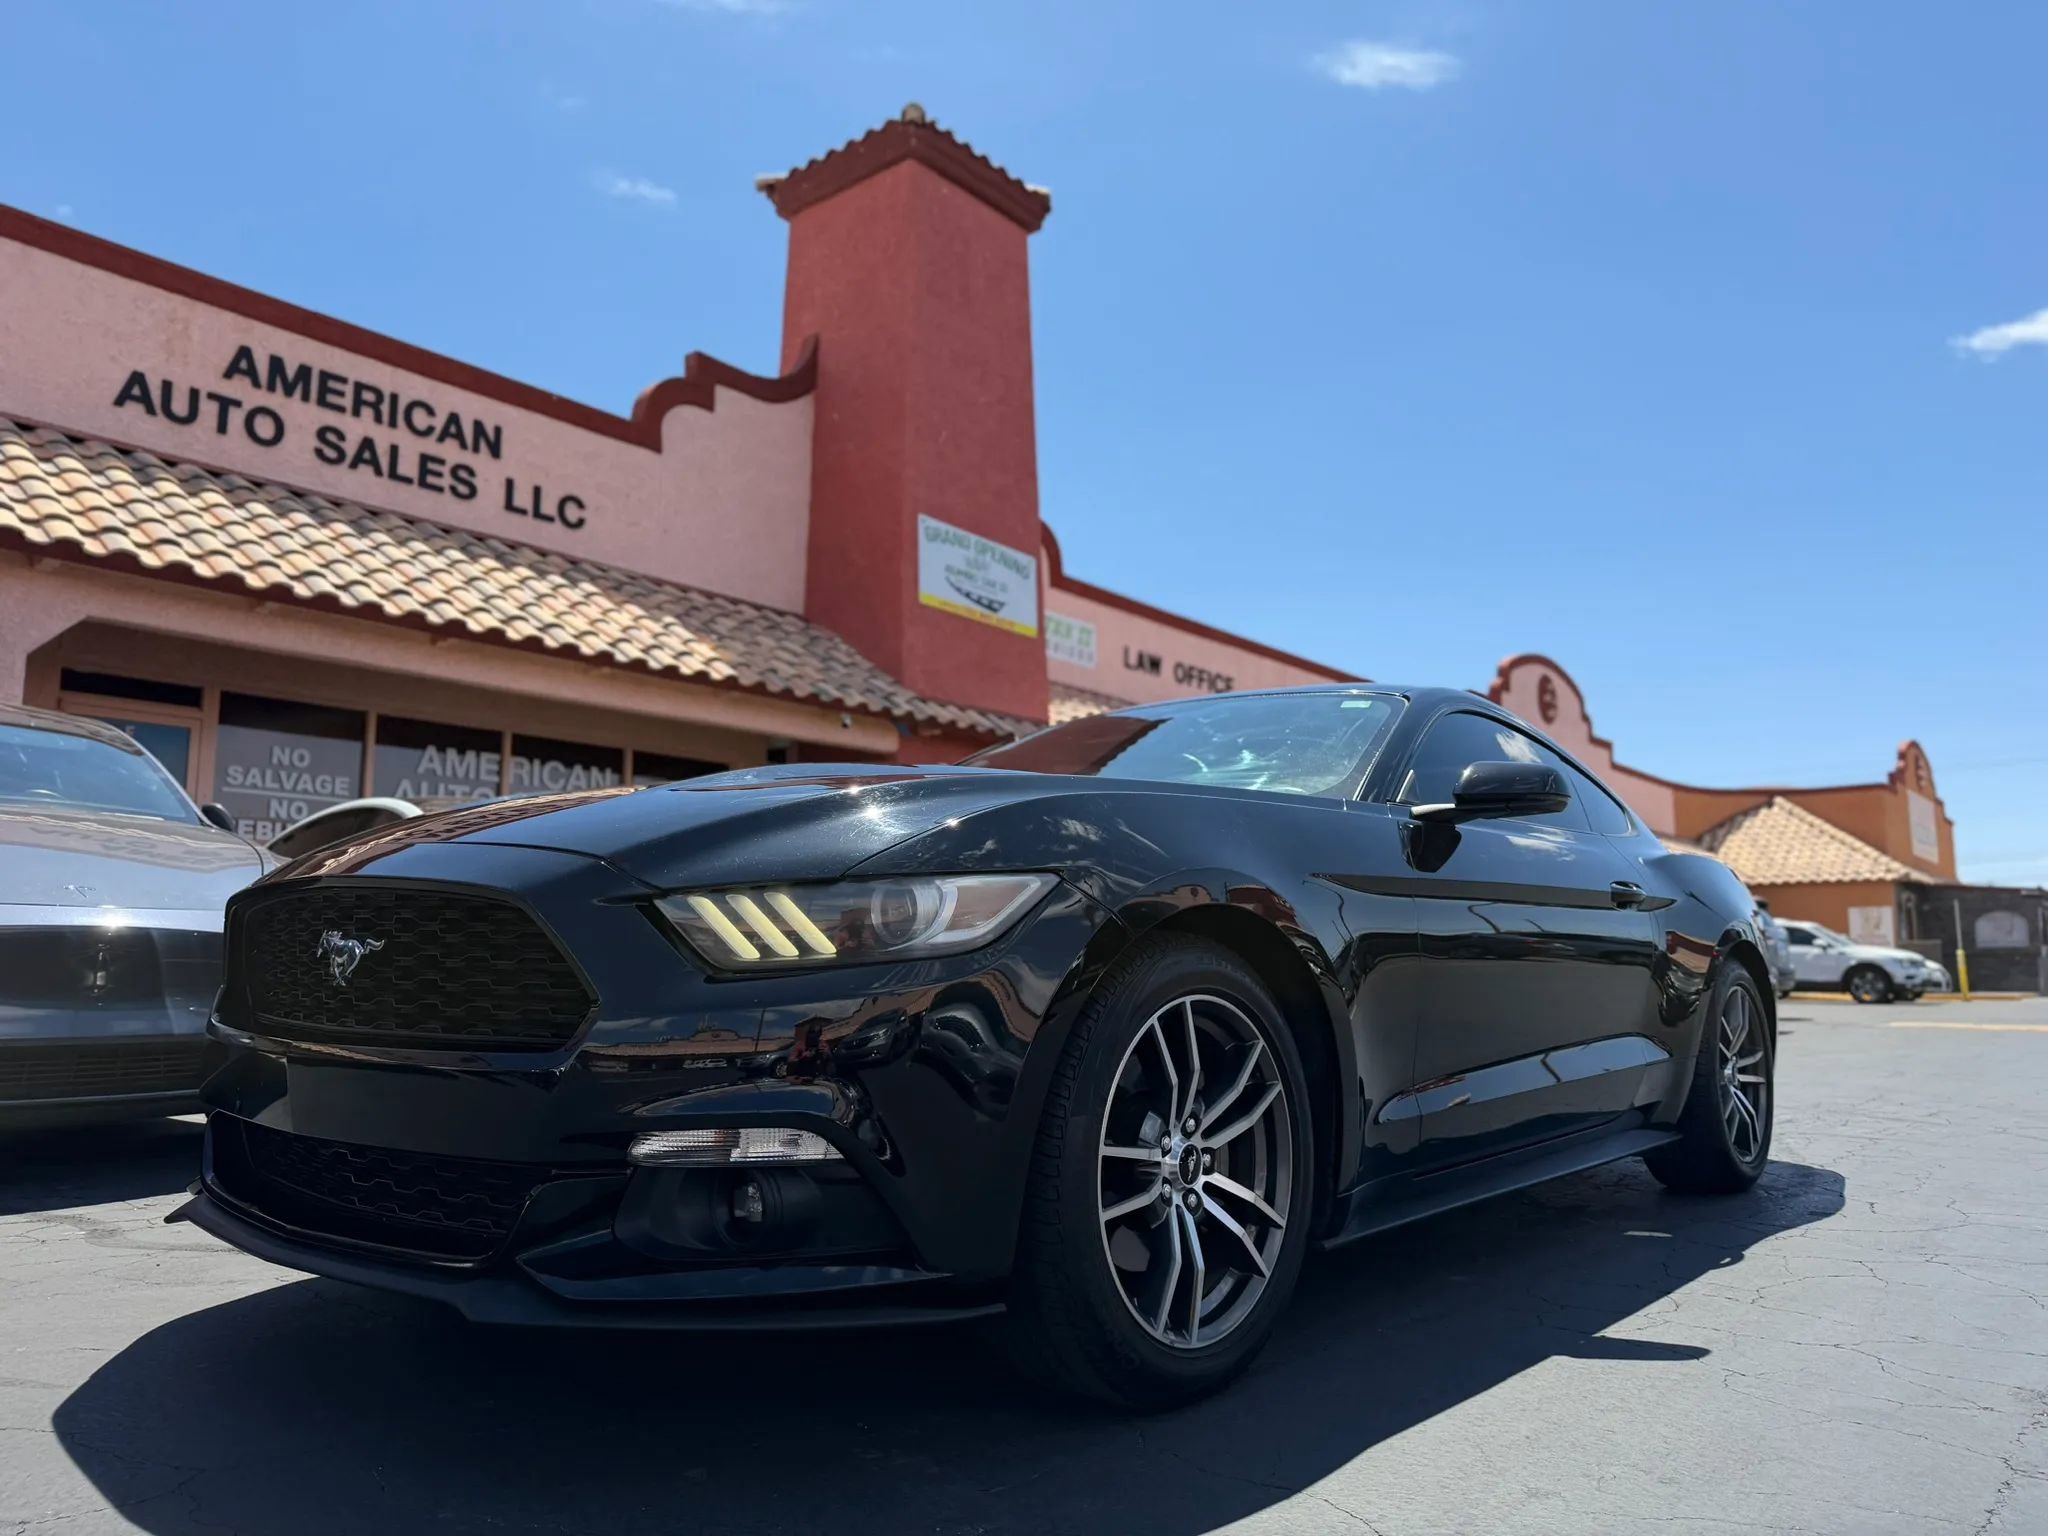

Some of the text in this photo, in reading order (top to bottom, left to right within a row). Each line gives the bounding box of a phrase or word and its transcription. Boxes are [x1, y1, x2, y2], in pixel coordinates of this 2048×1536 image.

[222, 345, 503, 459] AMERICAN
[113, 371, 586, 529] AUTO SALES LLC
[1123, 645, 1162, 677] LAW
[1174, 661, 1234, 694] OFFICE
[226, 765, 349, 795] SALVAGE
[271, 745, 310, 768] NO
[417, 744, 613, 792] AMERICAN
[269, 799, 308, 820] NO
